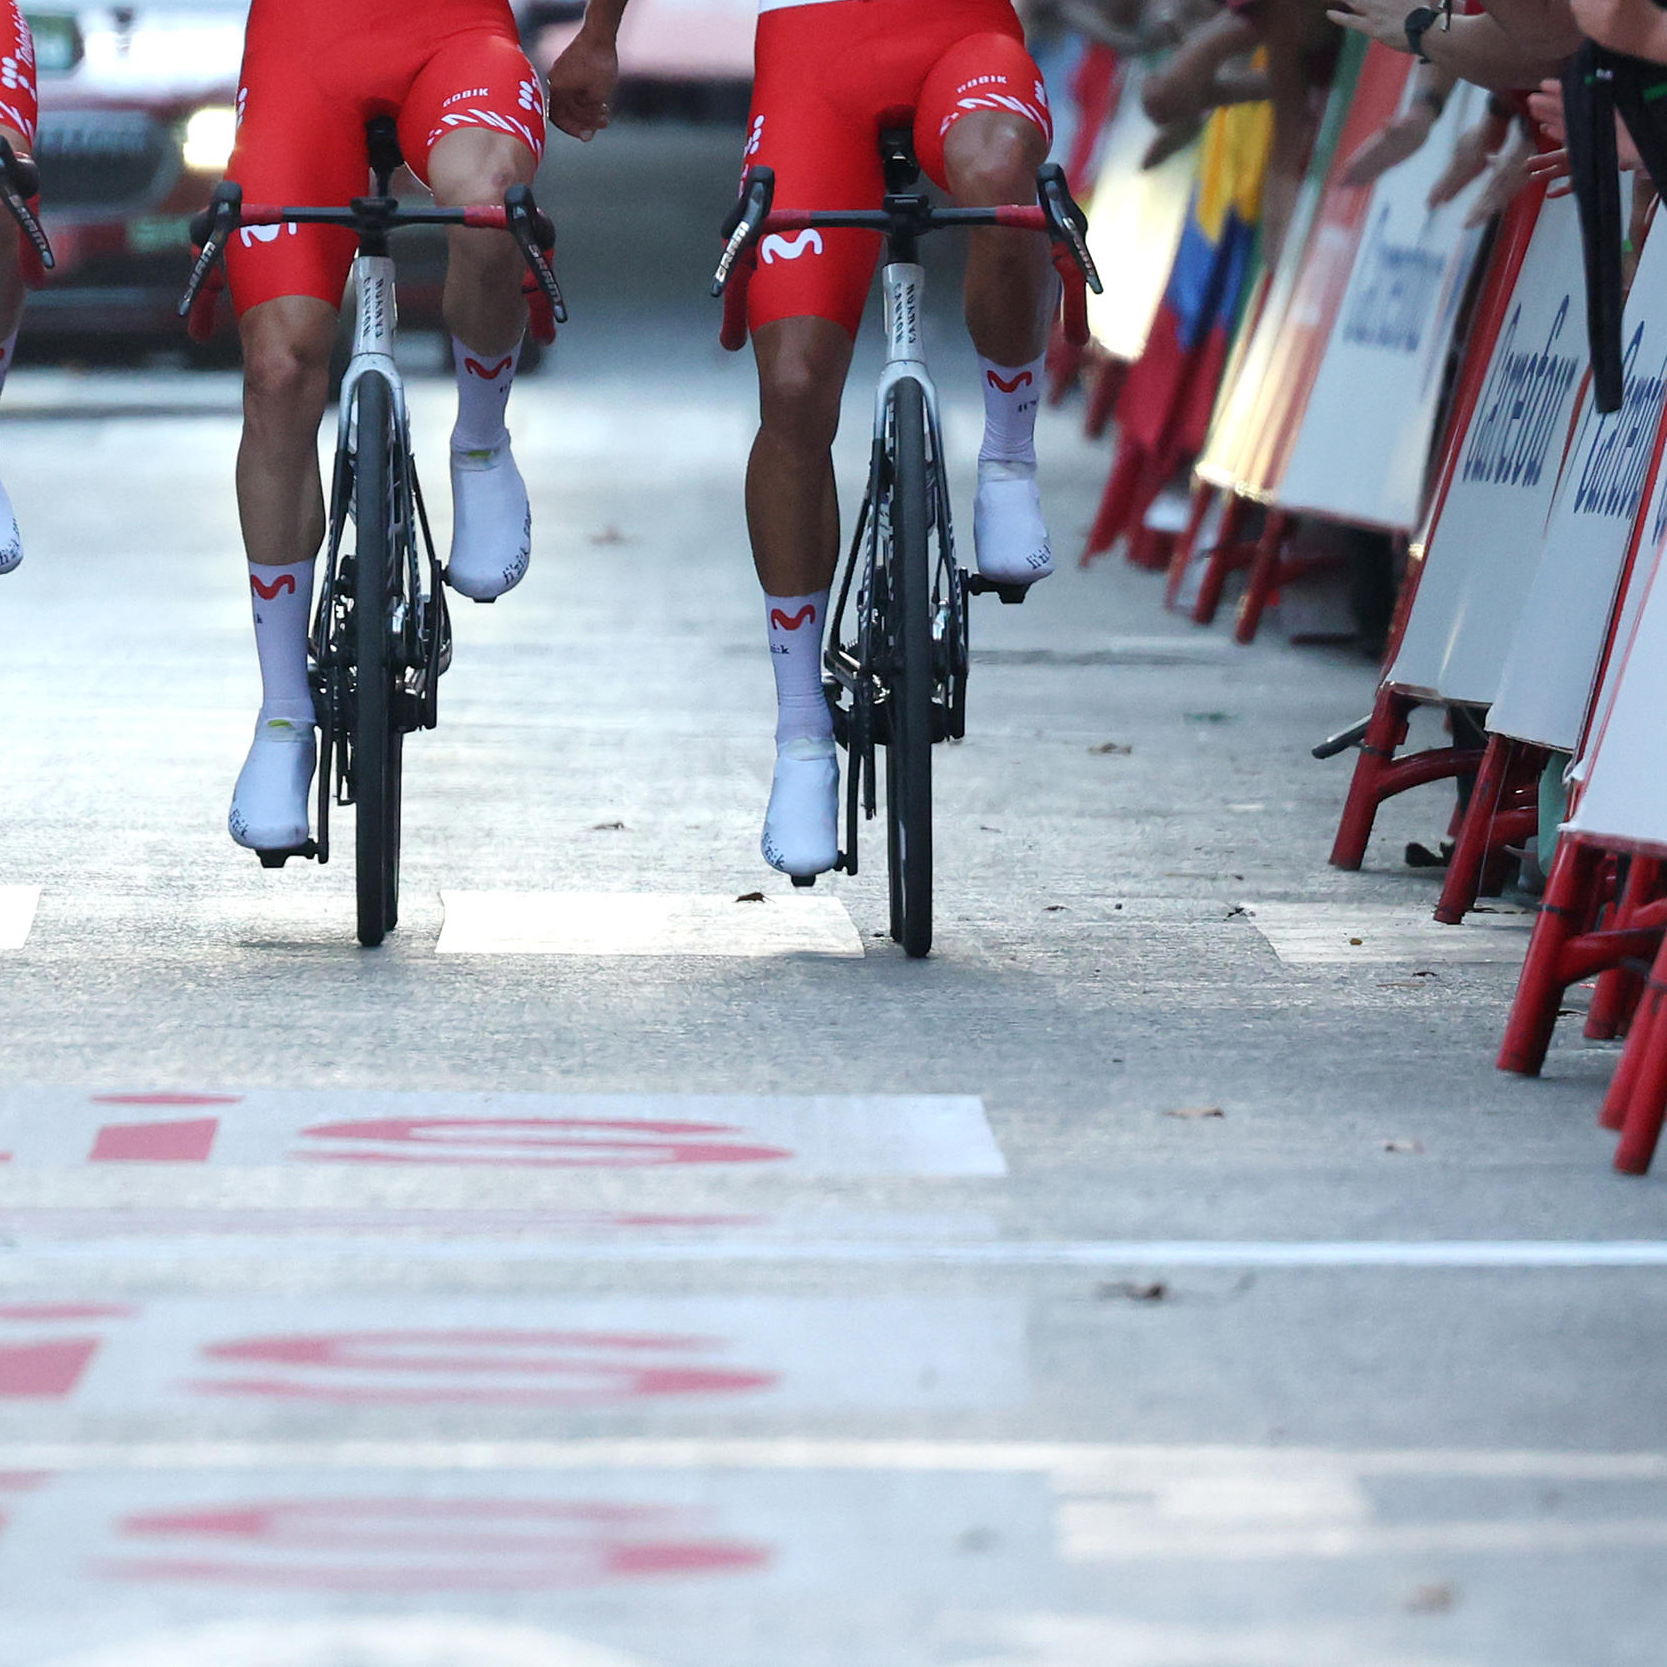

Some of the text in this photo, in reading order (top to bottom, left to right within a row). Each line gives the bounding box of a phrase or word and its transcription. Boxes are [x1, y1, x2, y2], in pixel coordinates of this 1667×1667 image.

[893, 282, 904, 345] CANYON
[905, 283, 916, 345] CANYON
[1463, 293, 1580, 488] Carrefour
